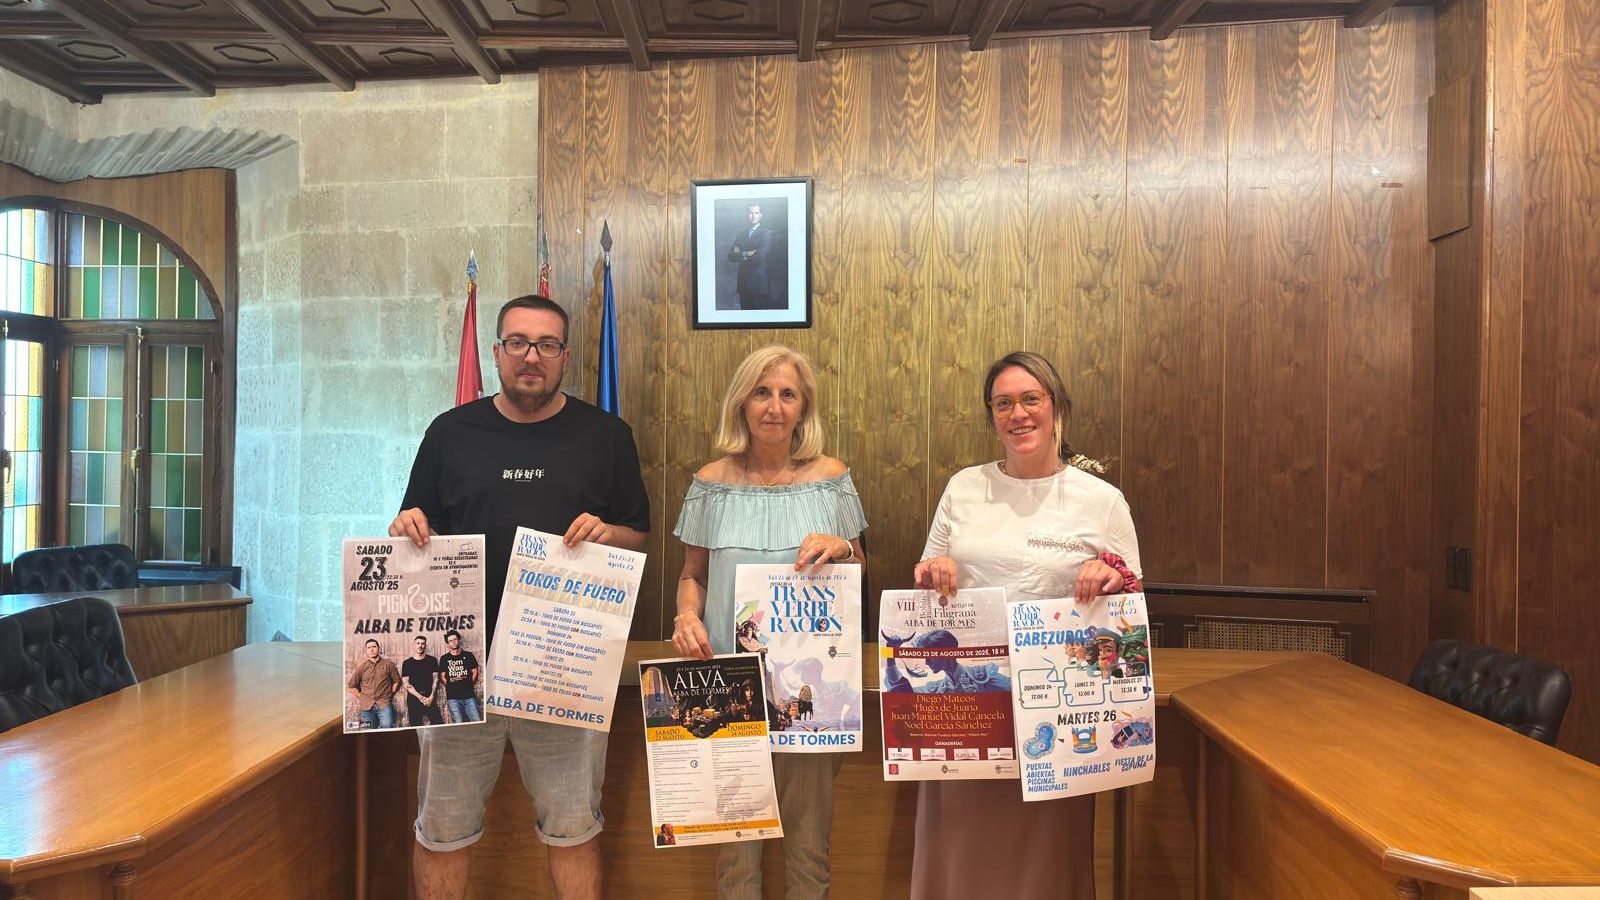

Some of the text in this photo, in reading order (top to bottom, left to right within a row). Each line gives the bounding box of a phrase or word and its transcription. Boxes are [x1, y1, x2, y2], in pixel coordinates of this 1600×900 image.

[356, 545, 393, 556] SABADO
[358, 556, 389, 582] 23
[518, 569, 626, 605] TOROS DE FUEGO
[377, 583, 451, 615] PIGNOISE
[770, 585, 836, 602] TRANS
[770, 600, 835, 617] VERBE
[897, 601, 915, 612] VIII
[933, 607, 977, 620] Filigrana
[354, 614, 476, 635] ALBA DE TORMES
[904, 619, 976, 628] ALBA DE TORMES
[898, 649, 921, 657] SÁBADO
[448, 669, 468, 679] Right
[673, 669, 728, 690] ALVA
[702, 686, 729, 696] TORMES
[1024, 684, 1046, 692] DOMINGO
[916, 694, 976, 705] Diego Mateos
[486, 694, 605, 724] ALBA DE TORMES
[914, 703, 979, 714] Hugo de Juana
[891, 712, 911, 722] Juan
[911, 712, 943, 721] Manuel
[944, 712, 967, 721] Vidal
[1057, 710, 1117, 726] MARTES 26
[728, 724, 762, 732] DOMINGO
[904, 720, 925, 730] Noel
[778, 734, 796, 746] DE
[799, 734, 856, 746] TORMES
[1115, 754, 1154, 767] FIESTA DE LA
[1026, 762, 1053, 772] PUERTAS
[1063, 762, 1111, 778] HINCHABLES
[1121, 760, 1148, 773] ESPUMA
[1026, 769, 1056, 779] ABIERTAS
[1027, 776, 1056, 787] PISCINAS
[1027, 782, 1069, 793] MUNICIPALES
